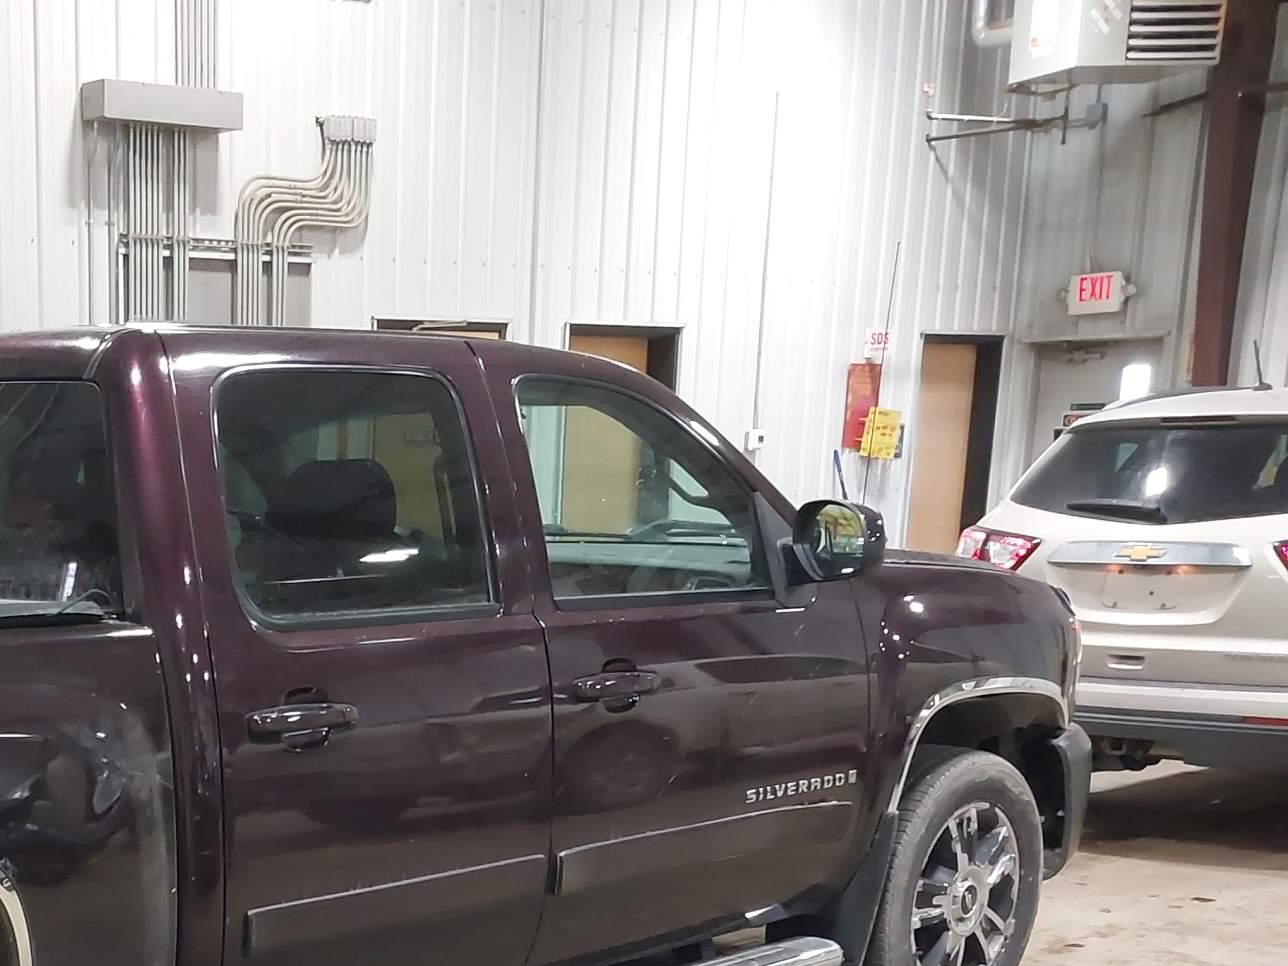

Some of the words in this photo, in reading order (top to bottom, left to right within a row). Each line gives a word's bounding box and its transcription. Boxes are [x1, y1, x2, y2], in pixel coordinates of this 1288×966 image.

[1079, 275, 1114, 302] EXIT
[870, 332, 889, 345] SDS
[745, 772, 846, 804] SILVERADO
